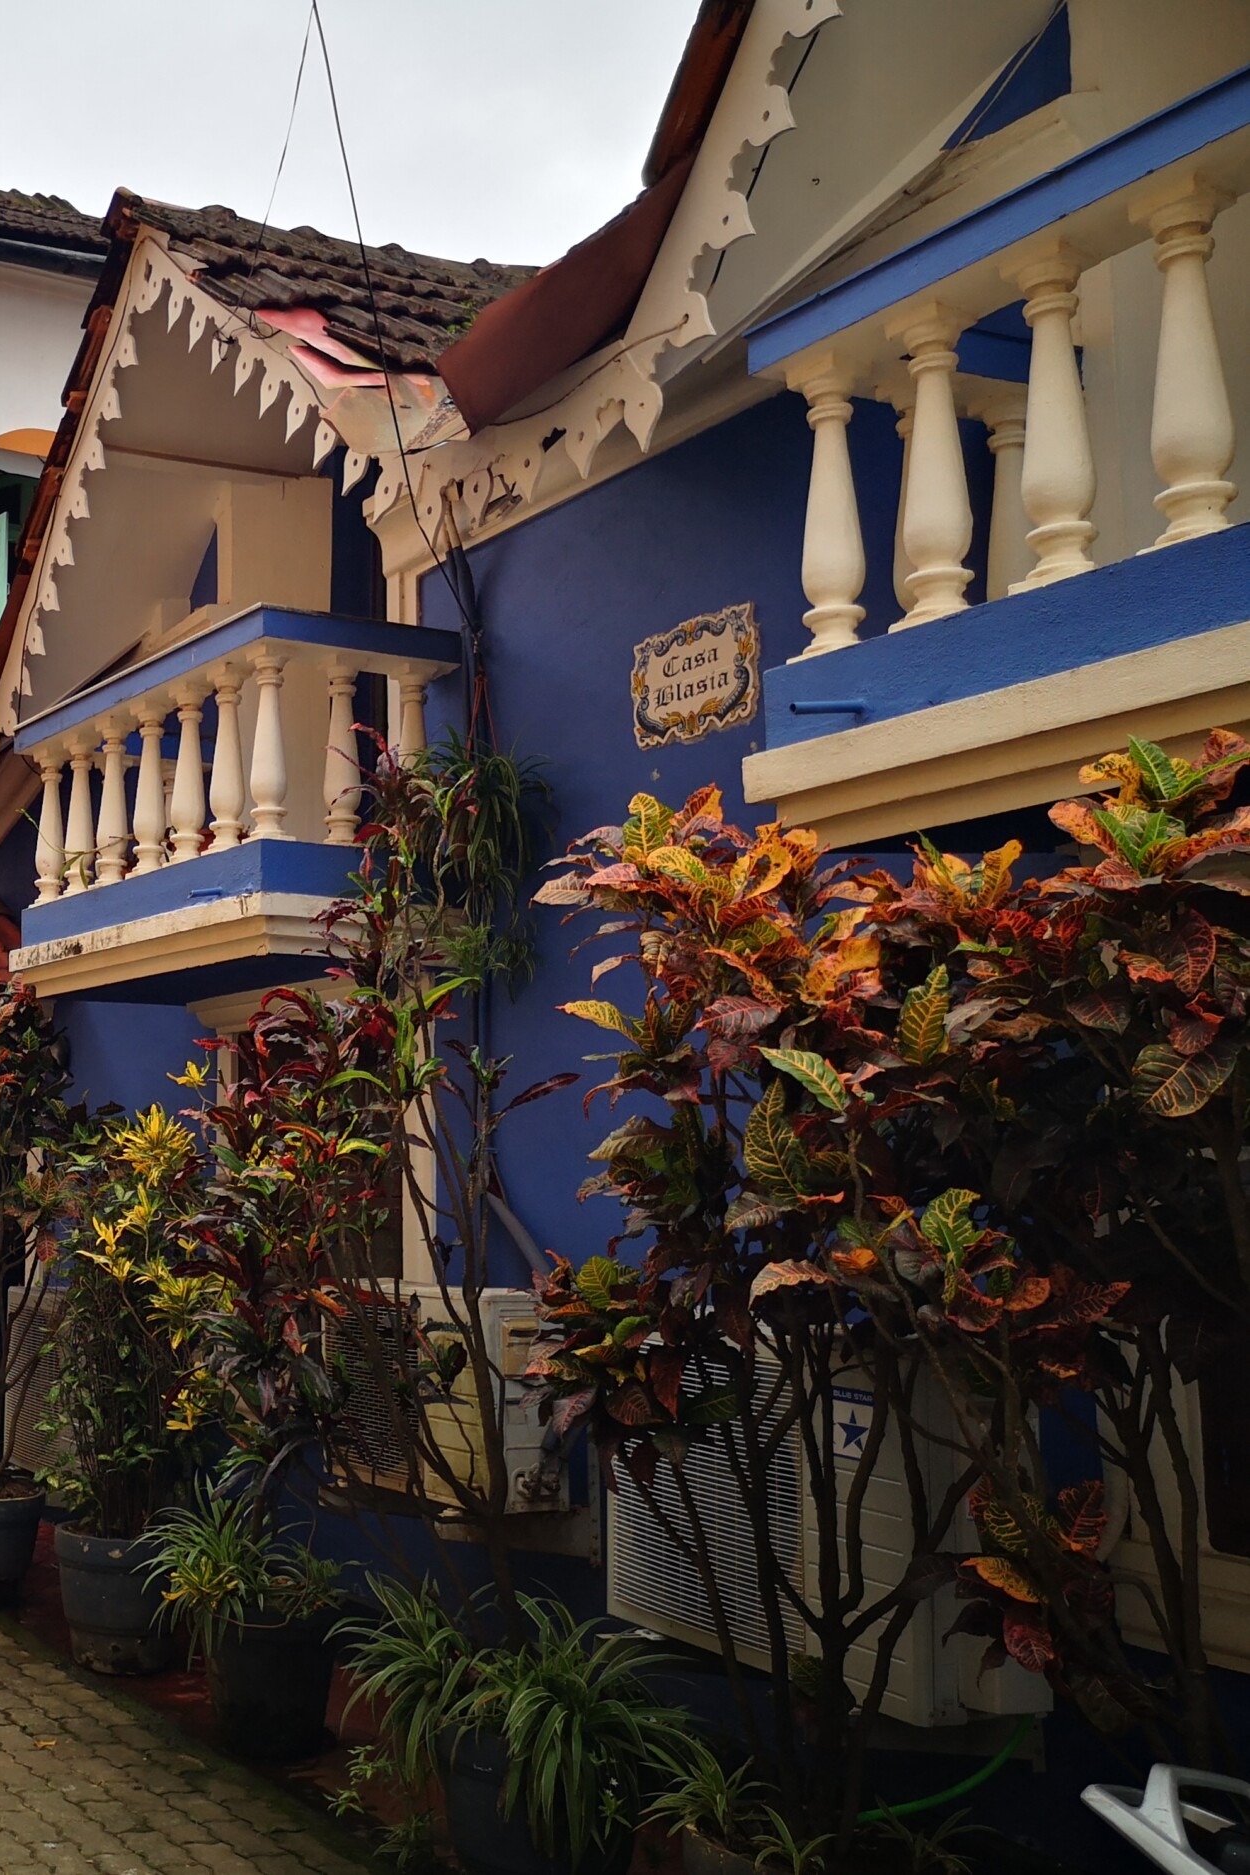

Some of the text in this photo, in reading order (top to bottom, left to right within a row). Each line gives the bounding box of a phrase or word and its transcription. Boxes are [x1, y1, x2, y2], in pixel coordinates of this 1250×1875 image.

[663, 648, 719, 678] Casa
[653, 671, 730, 712] Blasia
[833, 1389, 852, 1399] BLUE
